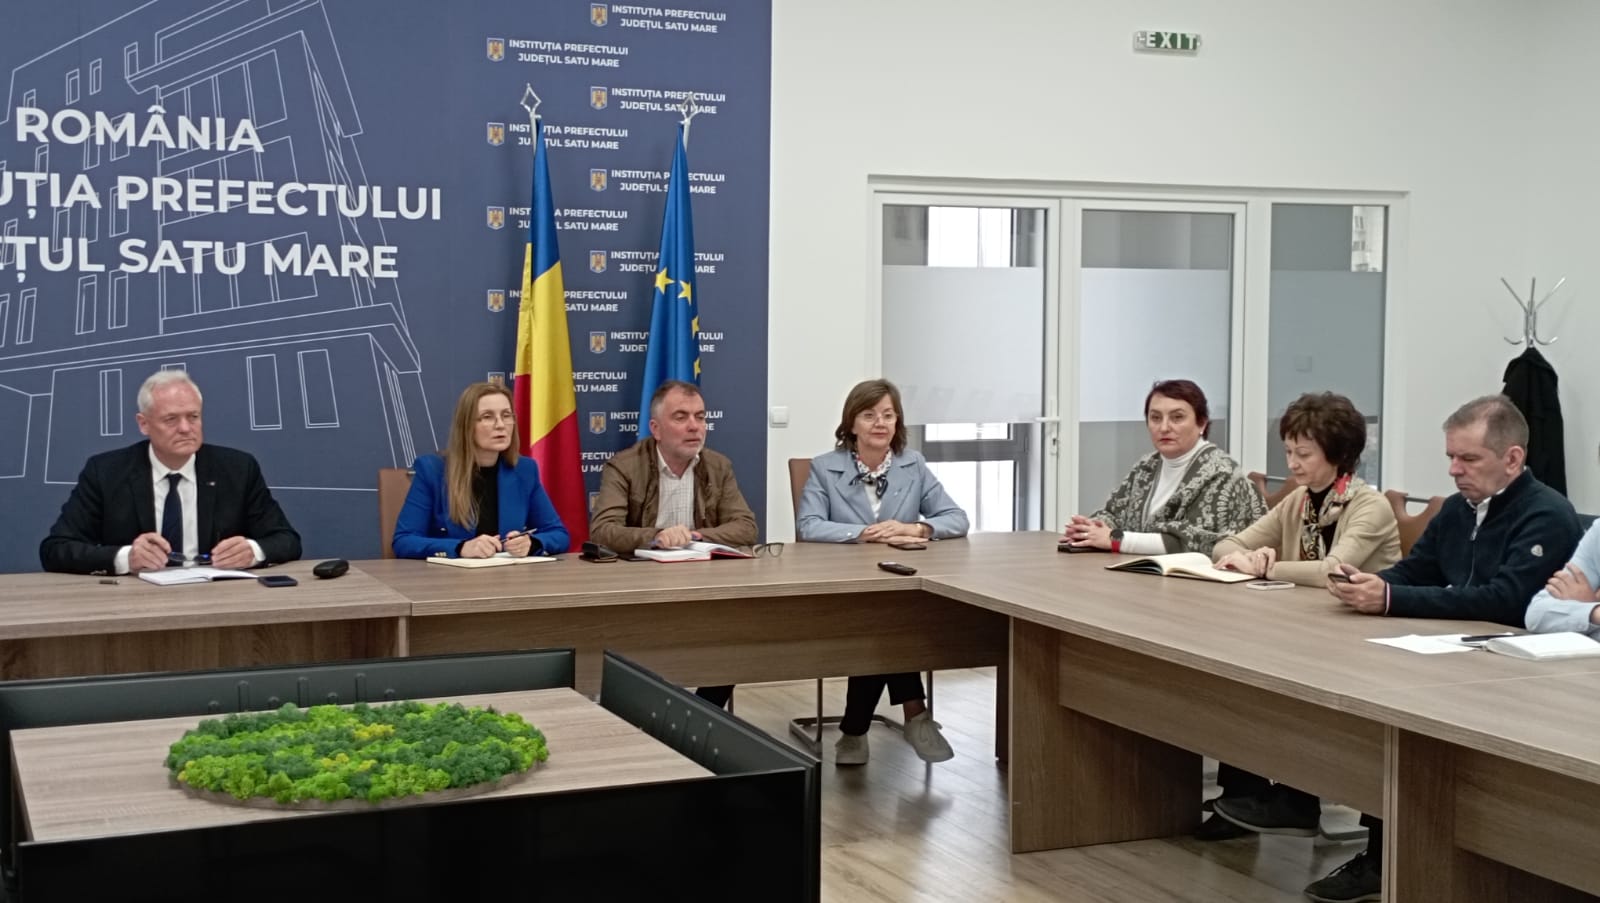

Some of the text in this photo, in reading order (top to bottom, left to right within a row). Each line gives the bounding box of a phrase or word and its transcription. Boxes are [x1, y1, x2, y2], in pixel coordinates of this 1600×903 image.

[612, 5, 726, 21] INSTITUȚIA PREFECTULUI
[620, 18, 718, 33] JUDEȚUL SATU MARE
[1146, 31, 1196, 50] EXIT
[509, 40, 628, 56] INSTITUȚIA PREFECTULUI
[517, 53, 620, 68] JUDEȚUL SATU MARE
[611, 87, 662, 100] INSTITUȚIA
[620, 101, 662, 112] JUDEȚUL
[16, 104, 264, 153] ROMÂNIA
[564, 126, 628, 137] PREFECTULUI
[564, 139, 589, 148] SATU
[591, 141, 619, 149] MARE
[611, 169, 661, 181] INSTITUȚIA
[620, 182, 662, 194] JUDEȚUL
[689, 185, 716, 194] MARE
[117, 175, 442, 220] PREFECTULUI
[563, 208, 628, 219] PREFECTULUI
[563, 221, 588, 230] SATU
[591, 222, 619, 231] MARE
[0, 235, 398, 283] ȚUL SATU MARE
[619, 264, 657, 274] JUDEȚU
[564, 290, 627, 300] PREFECTULUI
[564, 304, 618, 312] SATU MARE
[590, 384, 618, 392] MARE
